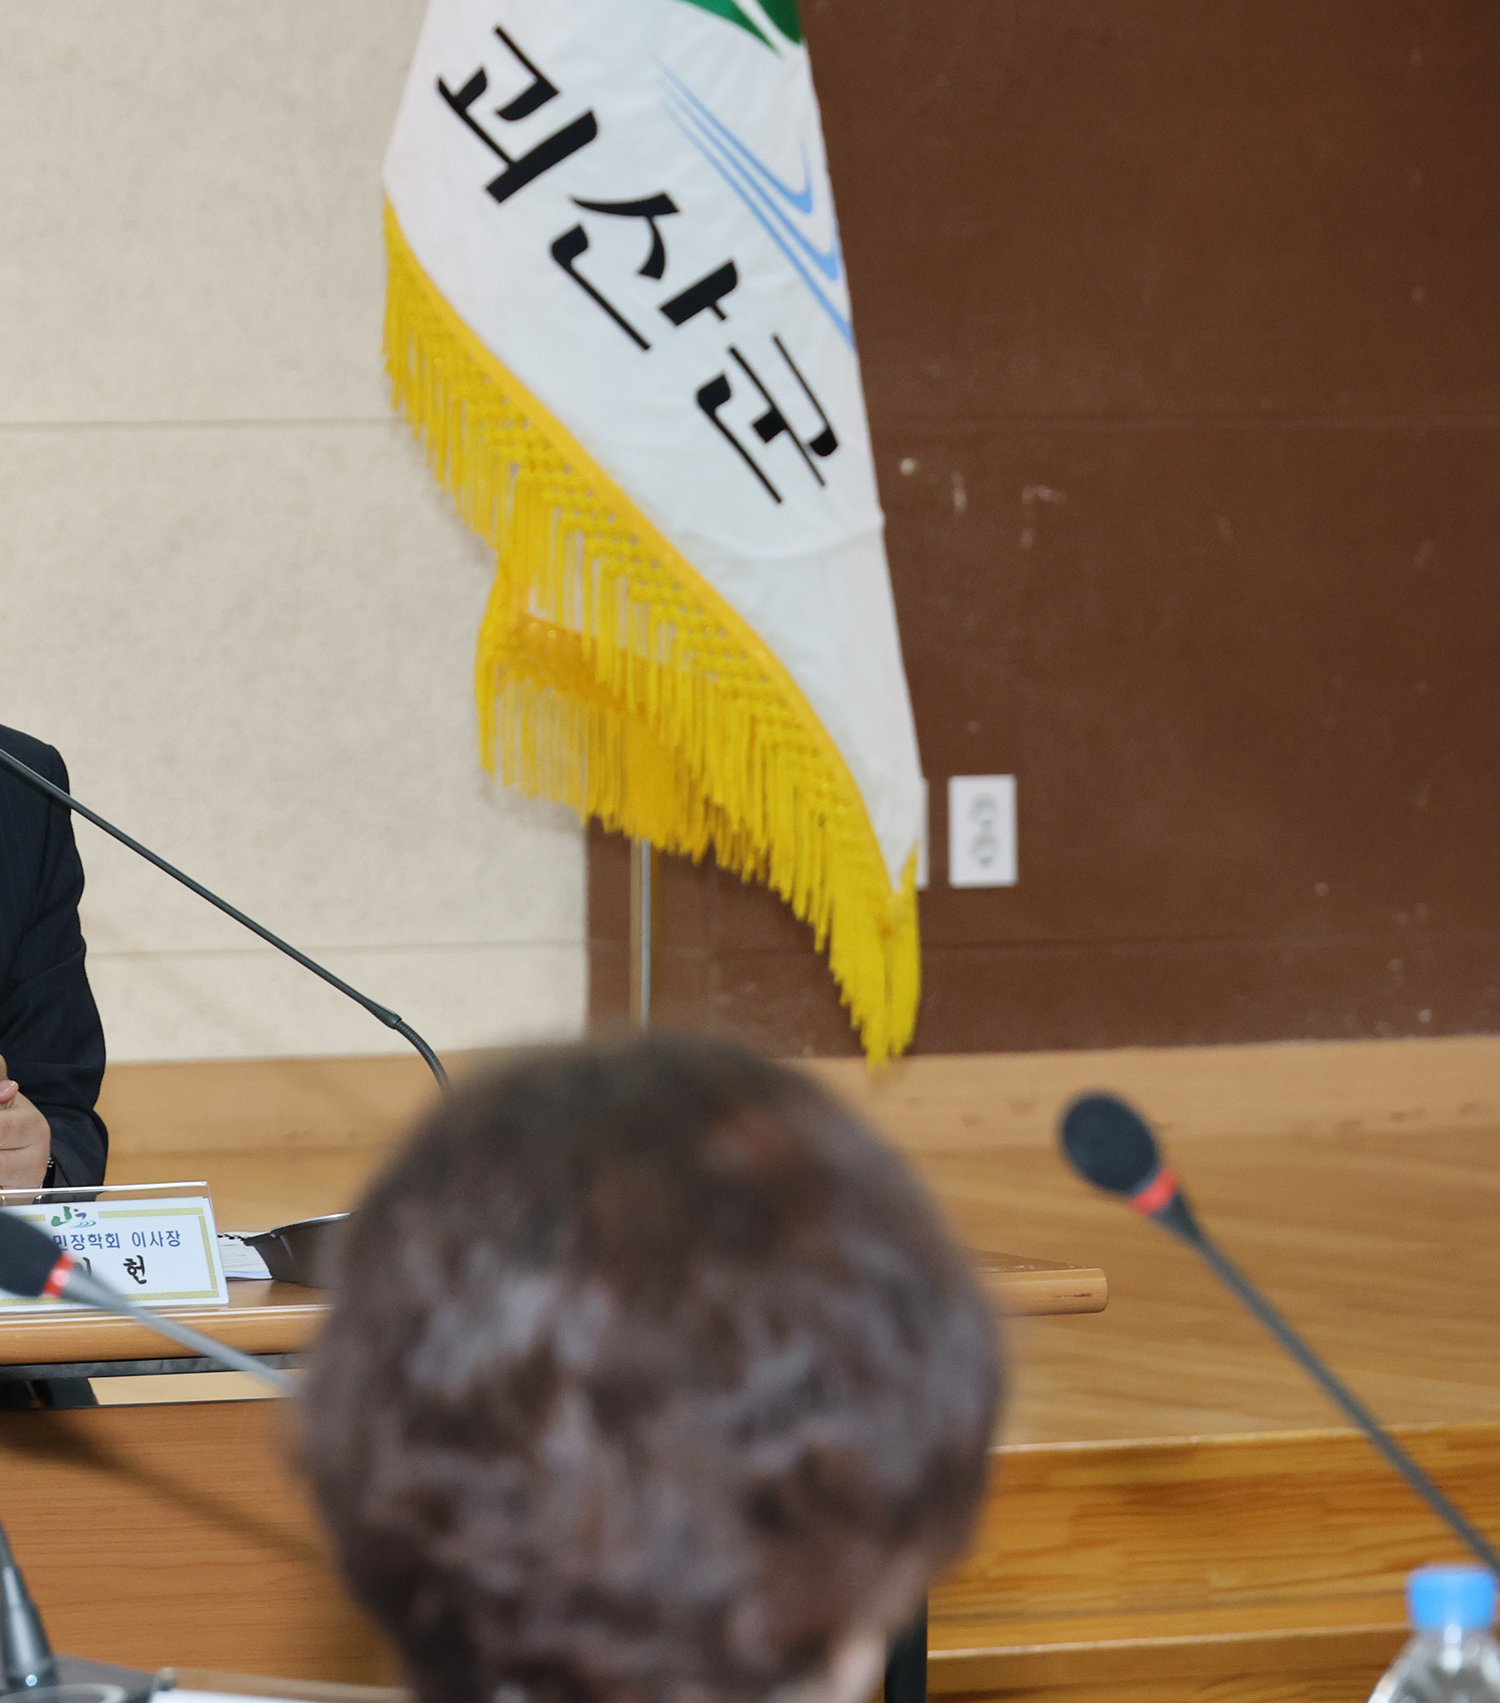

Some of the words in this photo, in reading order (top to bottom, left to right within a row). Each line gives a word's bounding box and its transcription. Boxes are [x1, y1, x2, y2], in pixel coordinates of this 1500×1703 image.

[436, 24, 839, 506] 괴산군
[131, 1230, 181, 1248] 이사장
[122, 1254, 148, 1285] 헌
